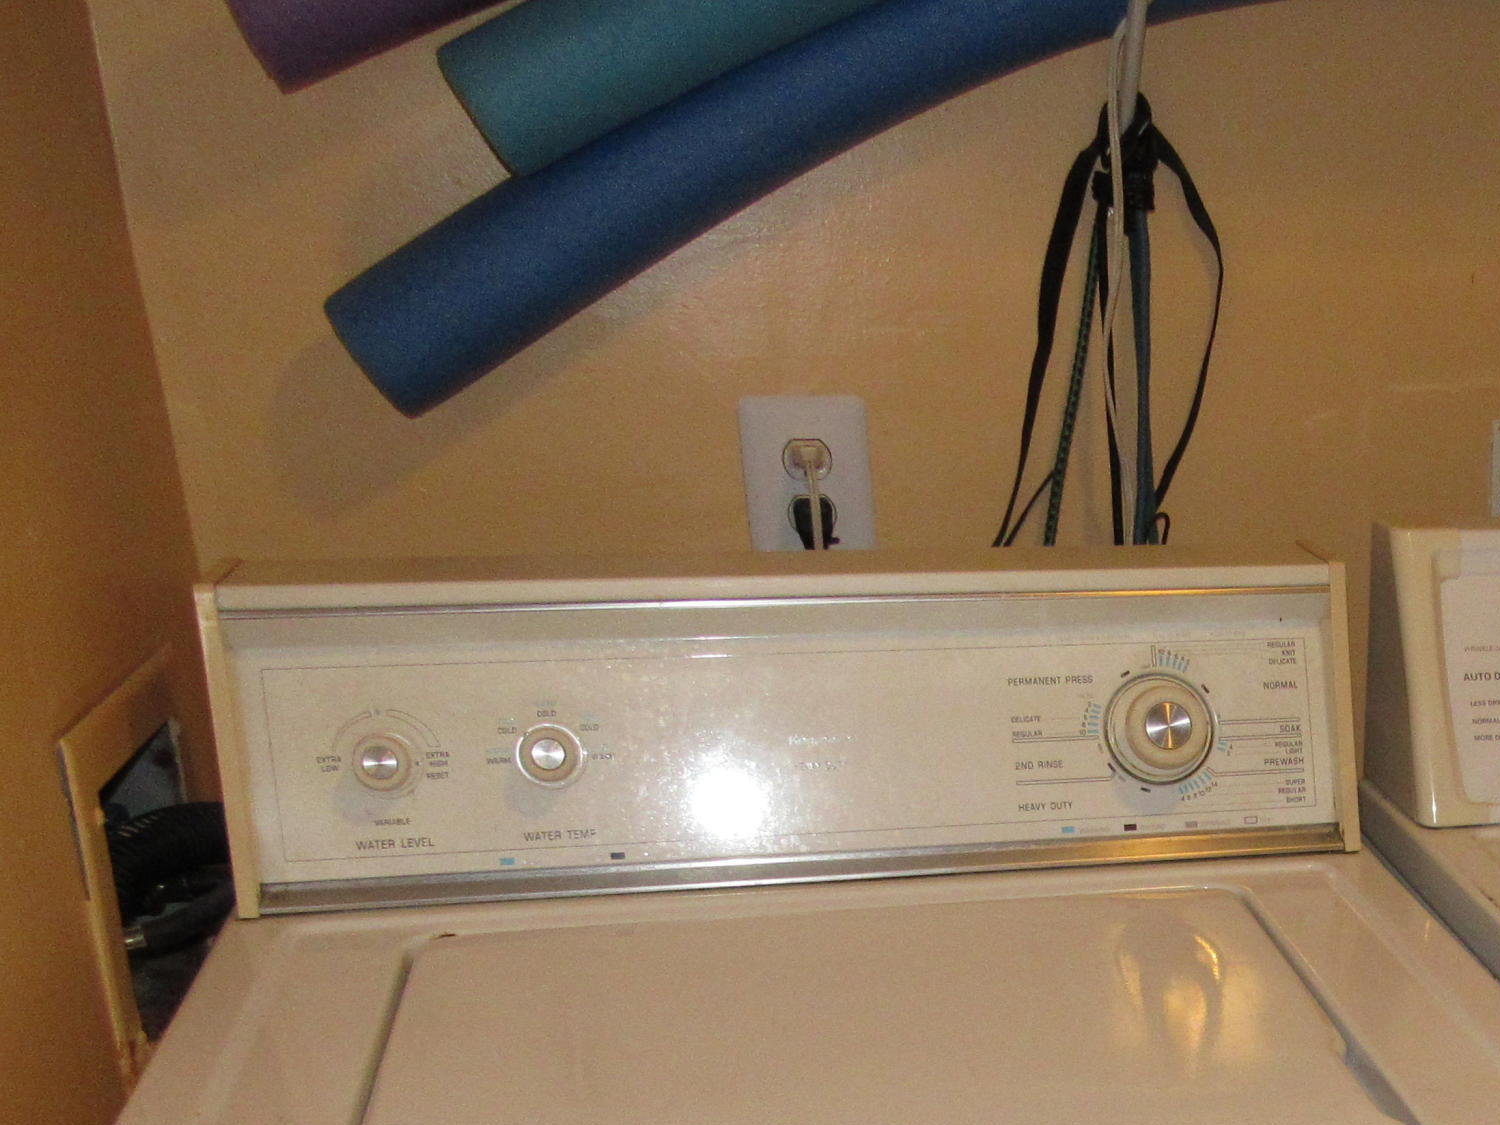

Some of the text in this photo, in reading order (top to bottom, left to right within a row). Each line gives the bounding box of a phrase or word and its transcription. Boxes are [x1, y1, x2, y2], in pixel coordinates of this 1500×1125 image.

[1008, 675, 1094, 687] PERMANENT PRESS
[1464, 672, 1491, 681] AUTO
[1263, 681, 1298, 690] NORMAL
[537, 710, 557, 718] COLD
[1011, 715, 1041, 723] DELICATE
[498, 727, 517, 735] COLD
[1280, 724, 1301, 733] SOAK
[425, 751, 450, 759] EXTRA
[487, 757, 512, 765] WARM
[1015, 760, 1064, 770] 2ND RINSE
[1264, 757, 1304, 766] PREWASH
[321, 765, 338, 773] LOW
[1018, 801, 1073, 812] HEAVY DUTY
[523, 829, 597, 841] WATER TEMP
[355, 837, 435, 850] WATER LEVEL
